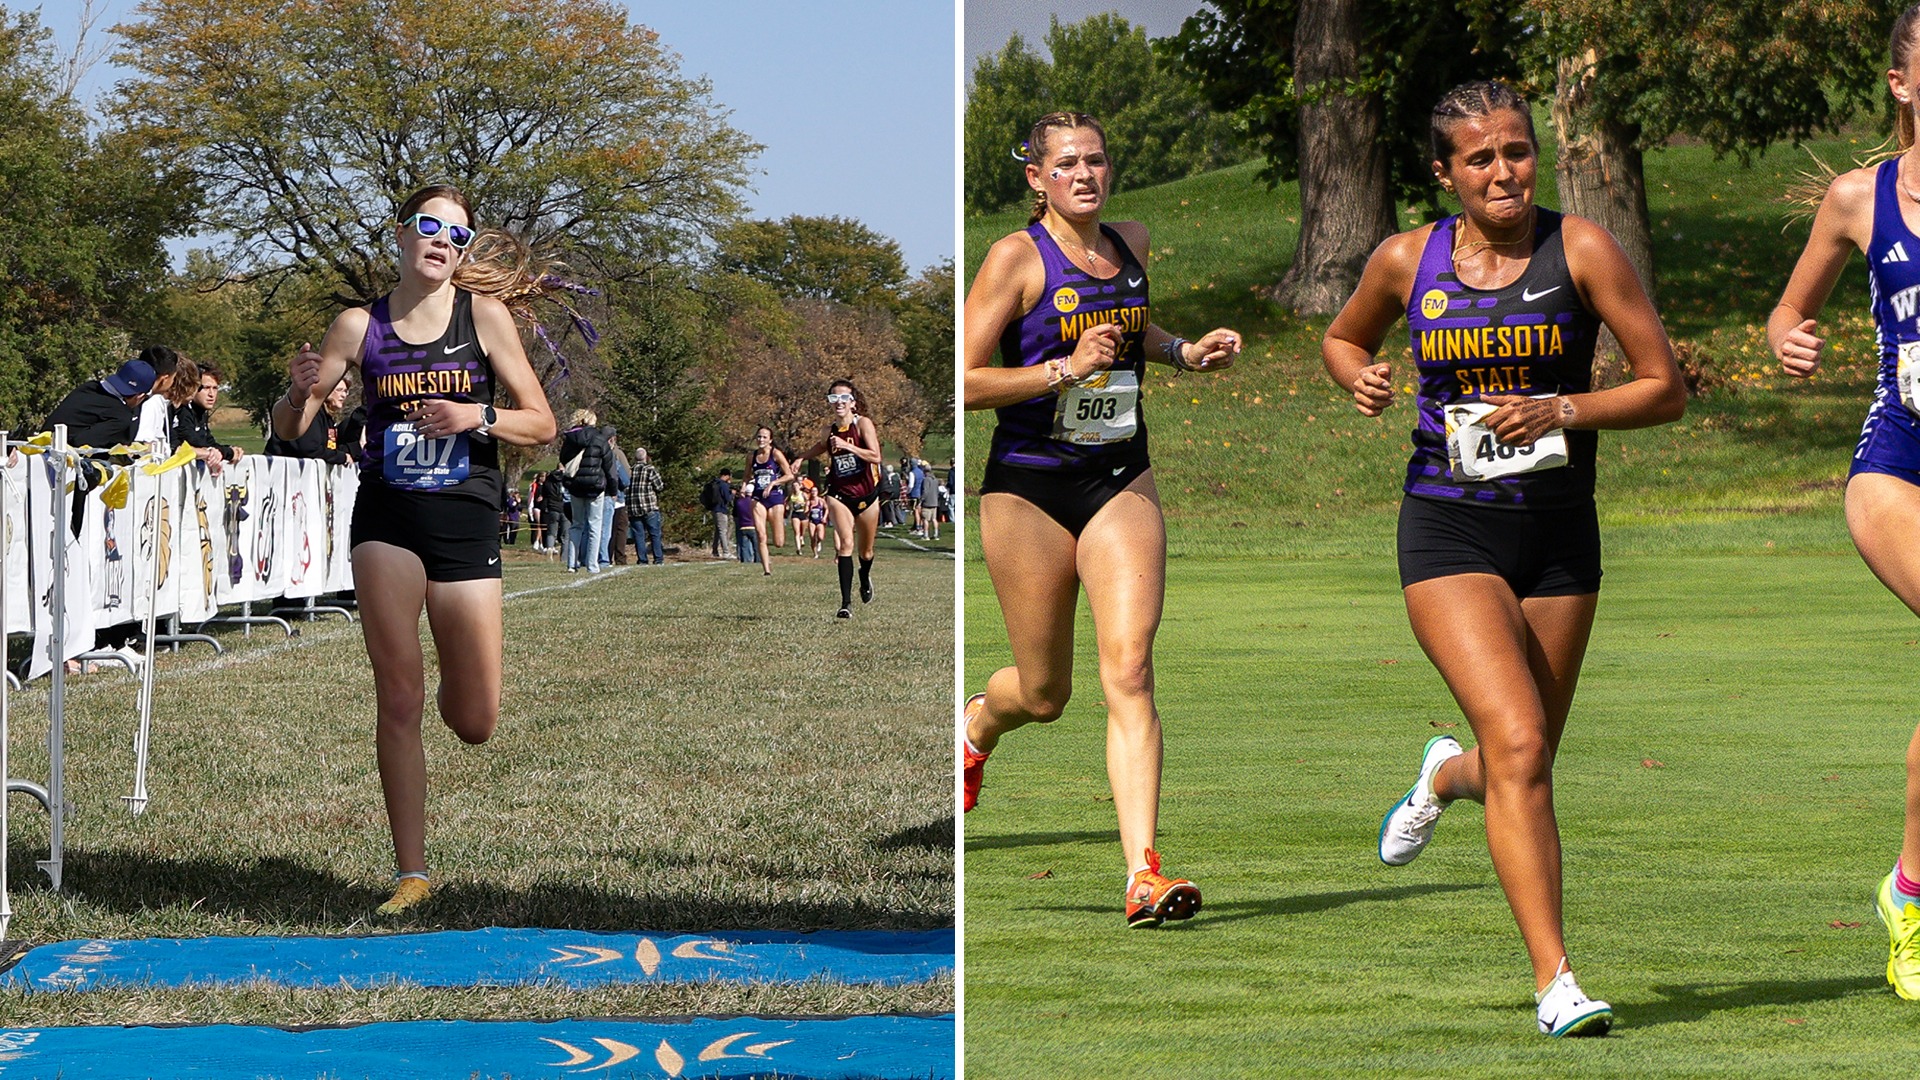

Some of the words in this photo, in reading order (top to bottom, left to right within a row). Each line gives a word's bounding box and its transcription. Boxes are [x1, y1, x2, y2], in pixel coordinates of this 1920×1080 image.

[1056, 294, 1077, 306] FM
[1423, 298, 1446, 311] FM
[1890, 284, 1920, 323] W
[1421, 325, 1561, 361] MINNESOTA
[377, 371, 471, 398] MINNESOTA
[1456, 367, 1531, 395] STATE
[1076, 397, 1117, 421] 503
[396, 432, 457, 467] 207
[403, 467, 433, 475] Minnesota
[433, 467, 450, 475] State
[836, 456, 857, 471] 259
